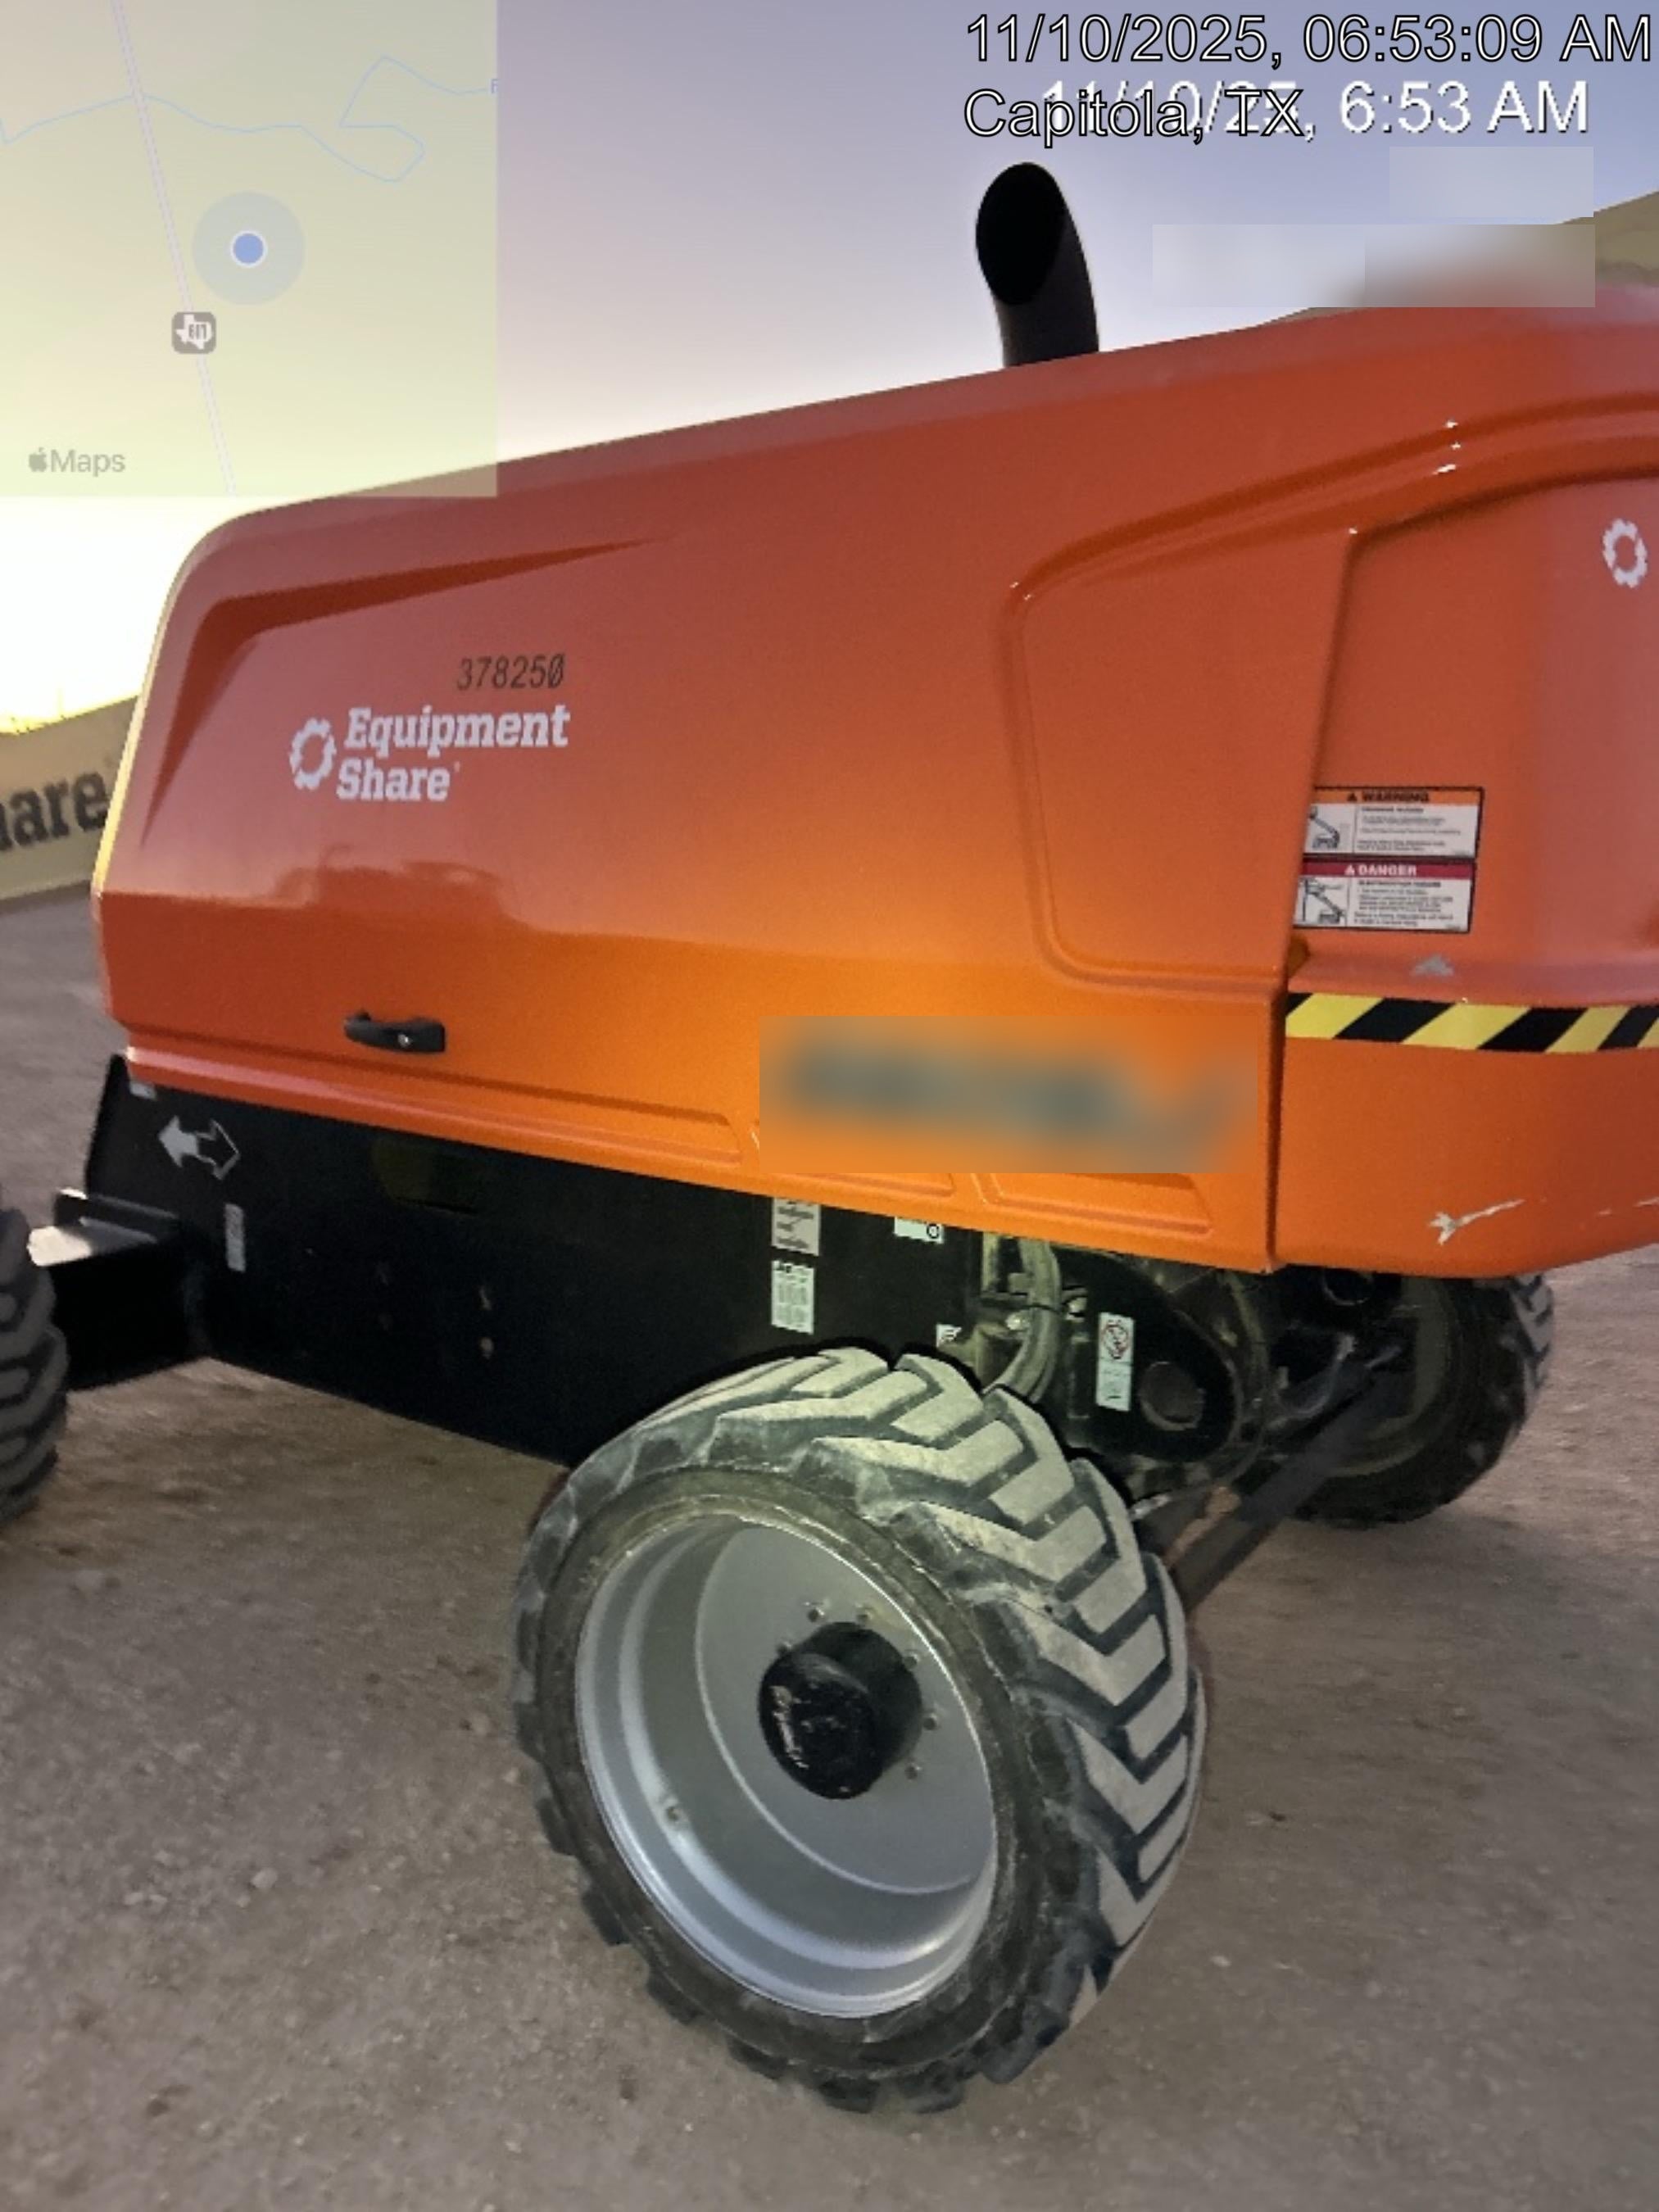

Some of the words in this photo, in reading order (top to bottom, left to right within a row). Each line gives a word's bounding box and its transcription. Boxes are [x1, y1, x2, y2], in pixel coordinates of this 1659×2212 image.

[456, 653, 566, 691] 378250
[344, 705, 571, 759] Equipment
[336, 757, 451, 802] Share
[1358, 864, 1417, 877] DANGER
